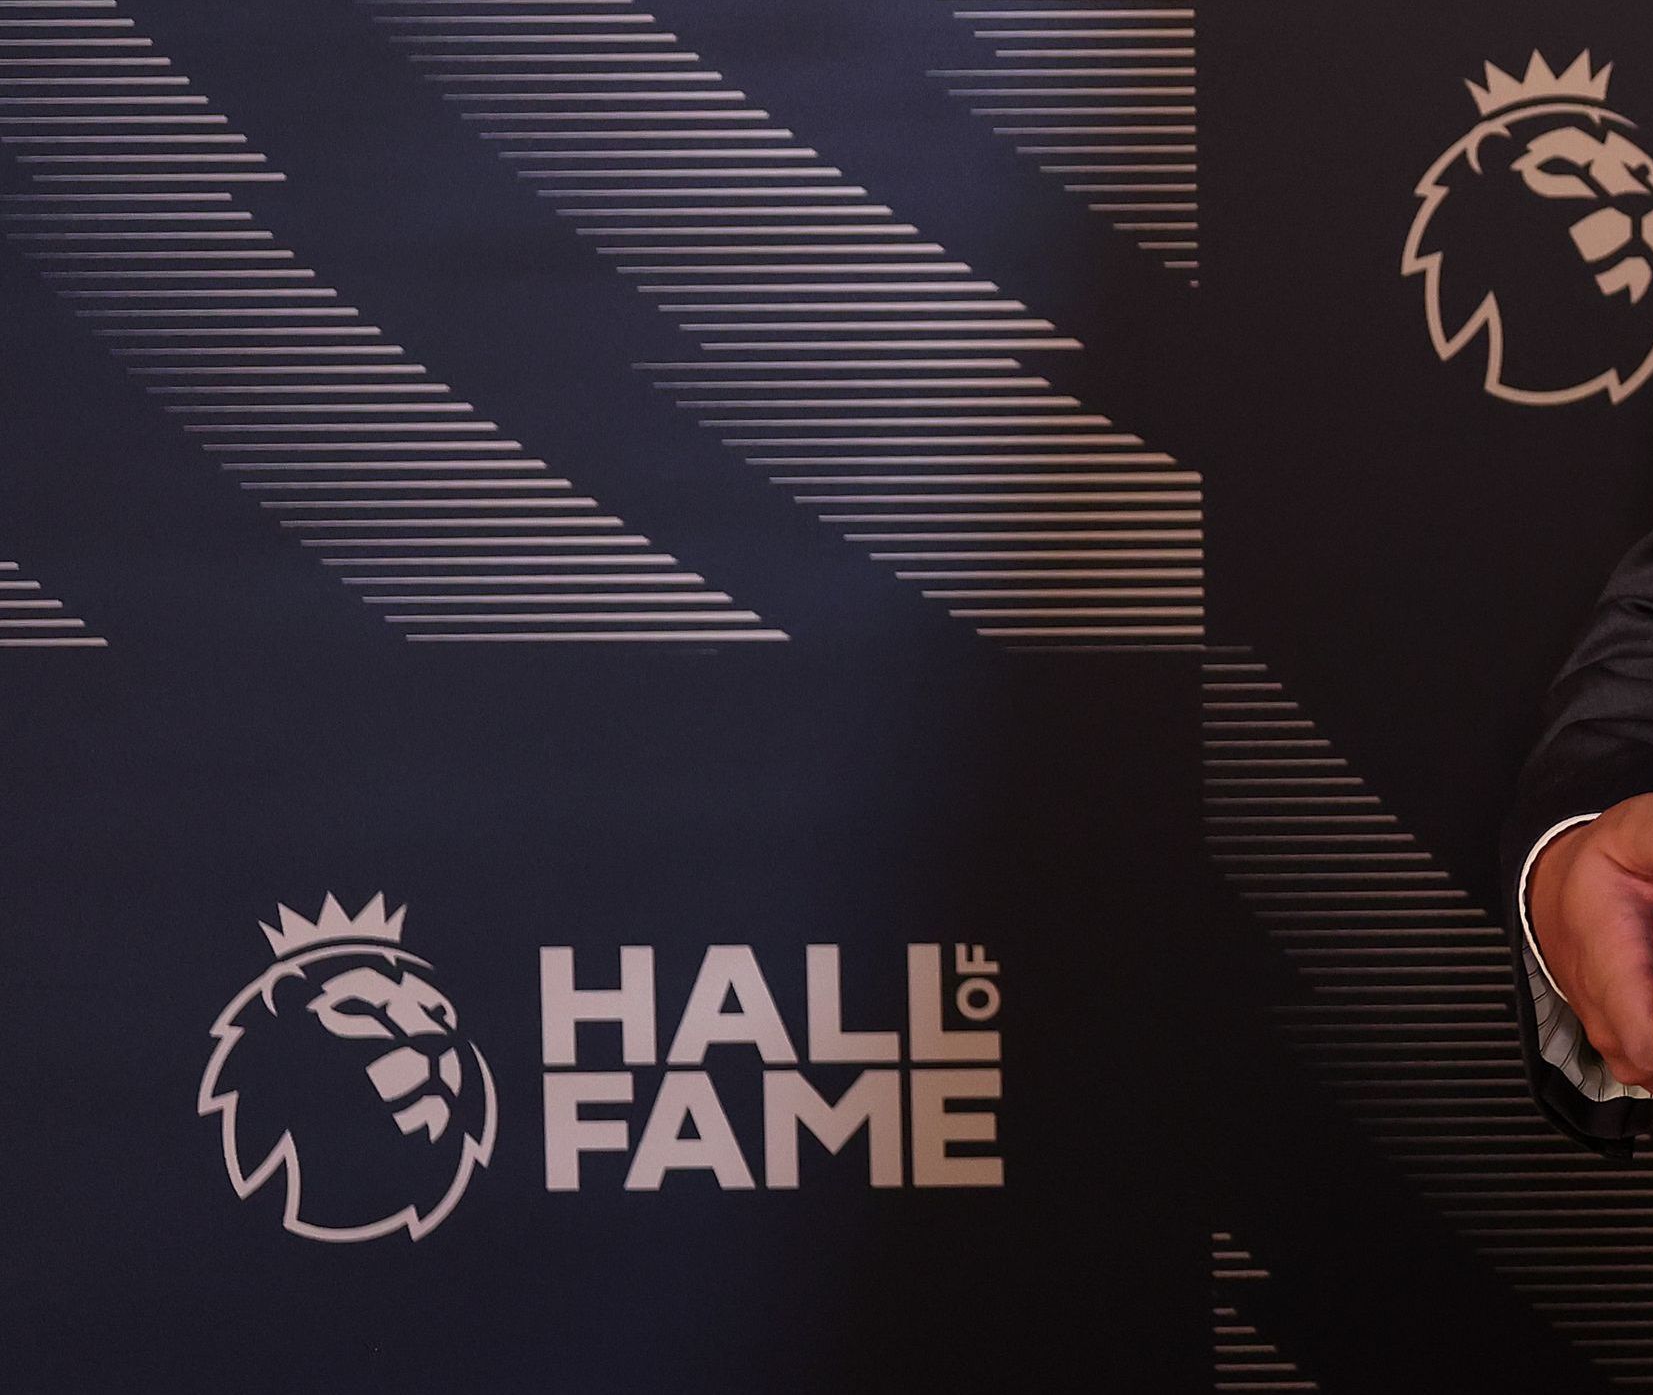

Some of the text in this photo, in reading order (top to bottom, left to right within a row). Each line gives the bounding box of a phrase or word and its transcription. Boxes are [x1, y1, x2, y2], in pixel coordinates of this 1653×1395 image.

[539, 943, 1001, 1065] HALL OF
[543, 1069, 1004, 1191] FAME
